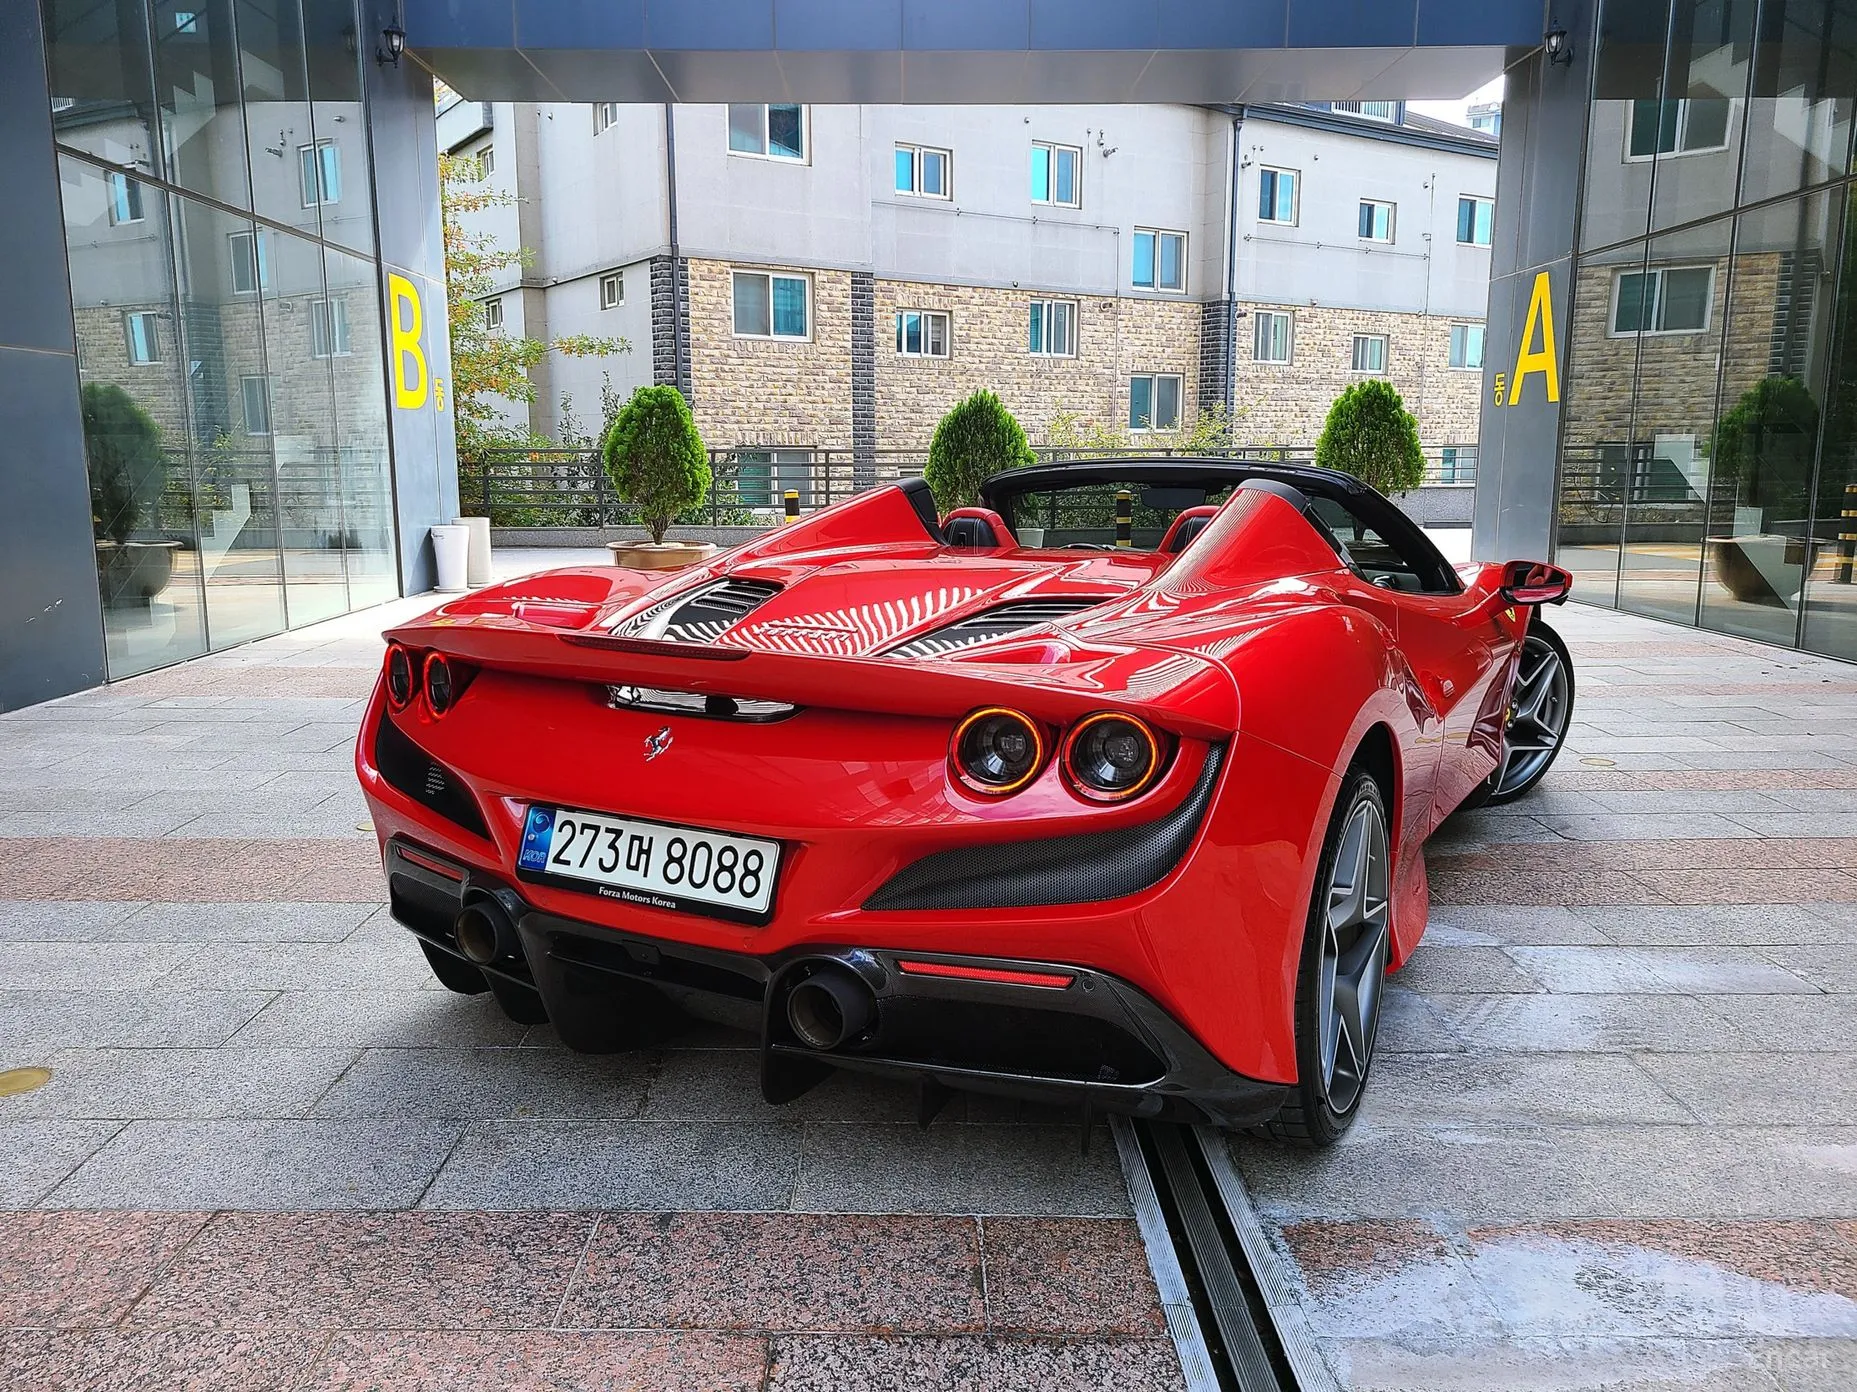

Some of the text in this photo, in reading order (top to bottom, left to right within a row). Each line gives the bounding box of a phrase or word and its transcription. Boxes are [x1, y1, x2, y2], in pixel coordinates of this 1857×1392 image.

[388, 272, 428, 410] B
[1508, 271, 1560, 406] A
[1493, 373, 1505, 407] 동
[522, 849, 547, 864] KOR
[552, 819, 765, 899] 273머 8088
[598, 886, 676, 909] Forza Motors Korea
